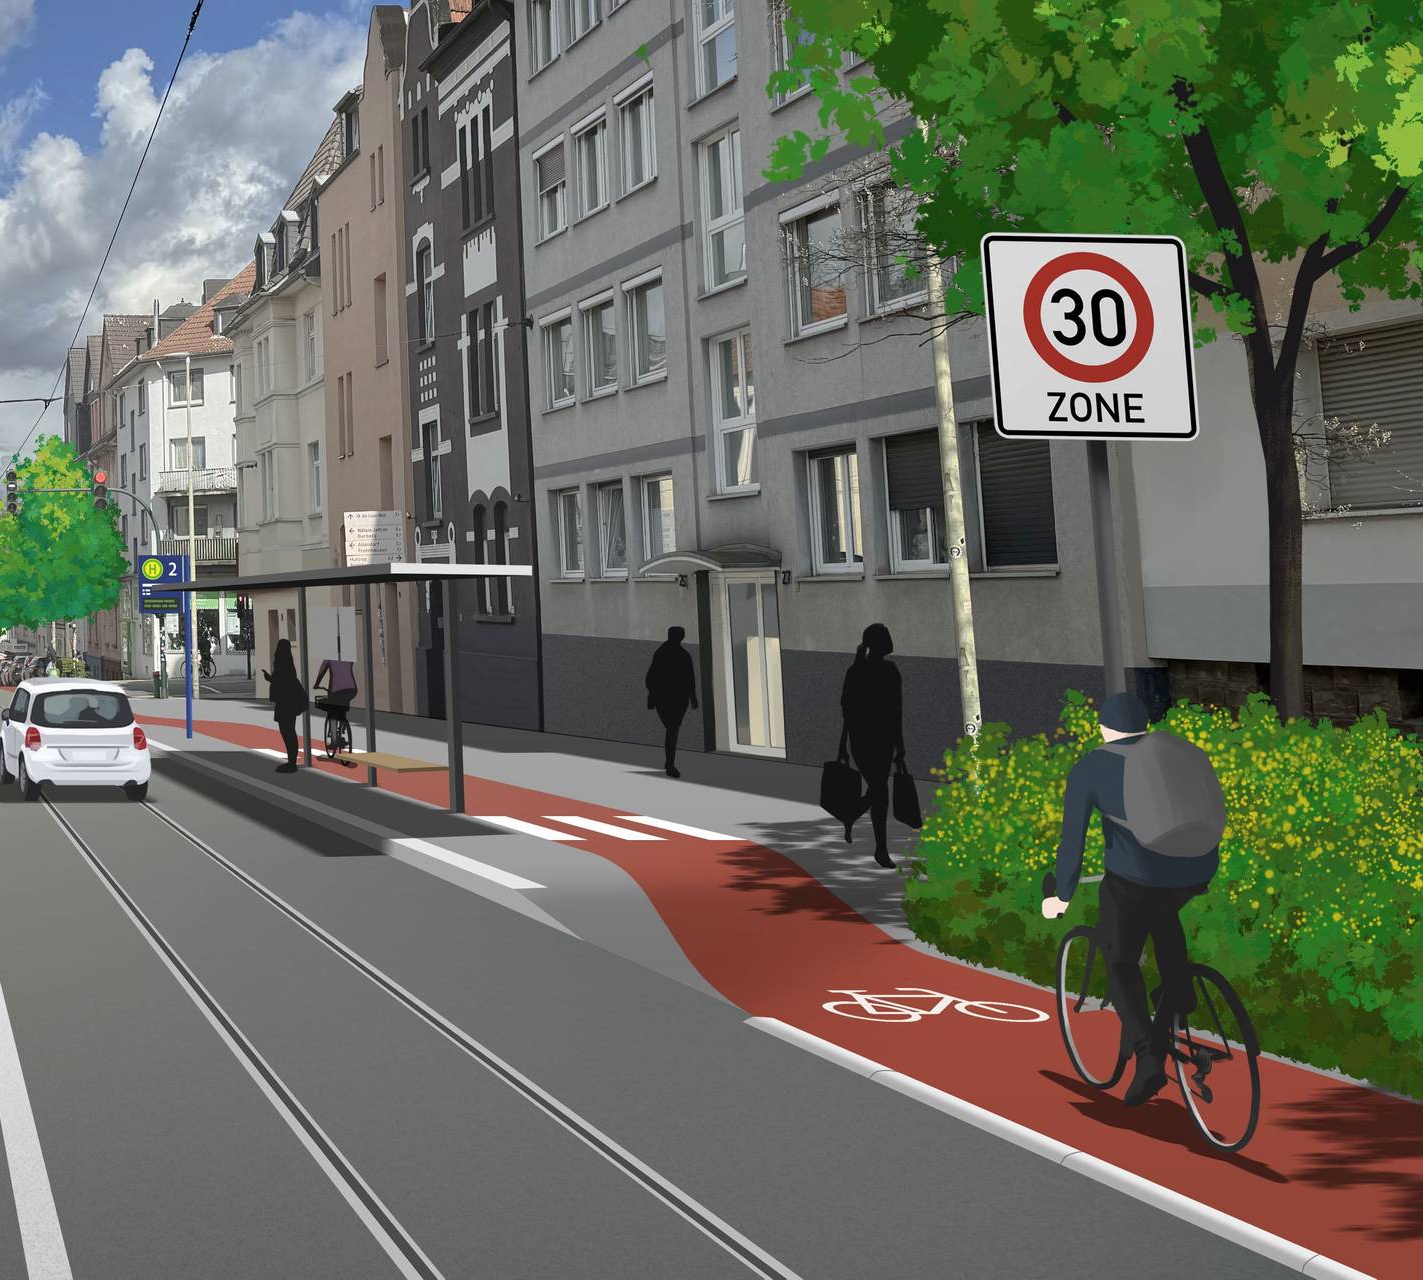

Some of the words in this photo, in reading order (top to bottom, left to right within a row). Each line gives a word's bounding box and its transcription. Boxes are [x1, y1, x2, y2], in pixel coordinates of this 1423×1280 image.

[1050, 287, 1127, 347] 30
[1047, 392, 1145, 423] ZONE
[149, 563, 157, 575] H
[168, 562, 177, 576] 2
[782, 570, 791, 585] 27
